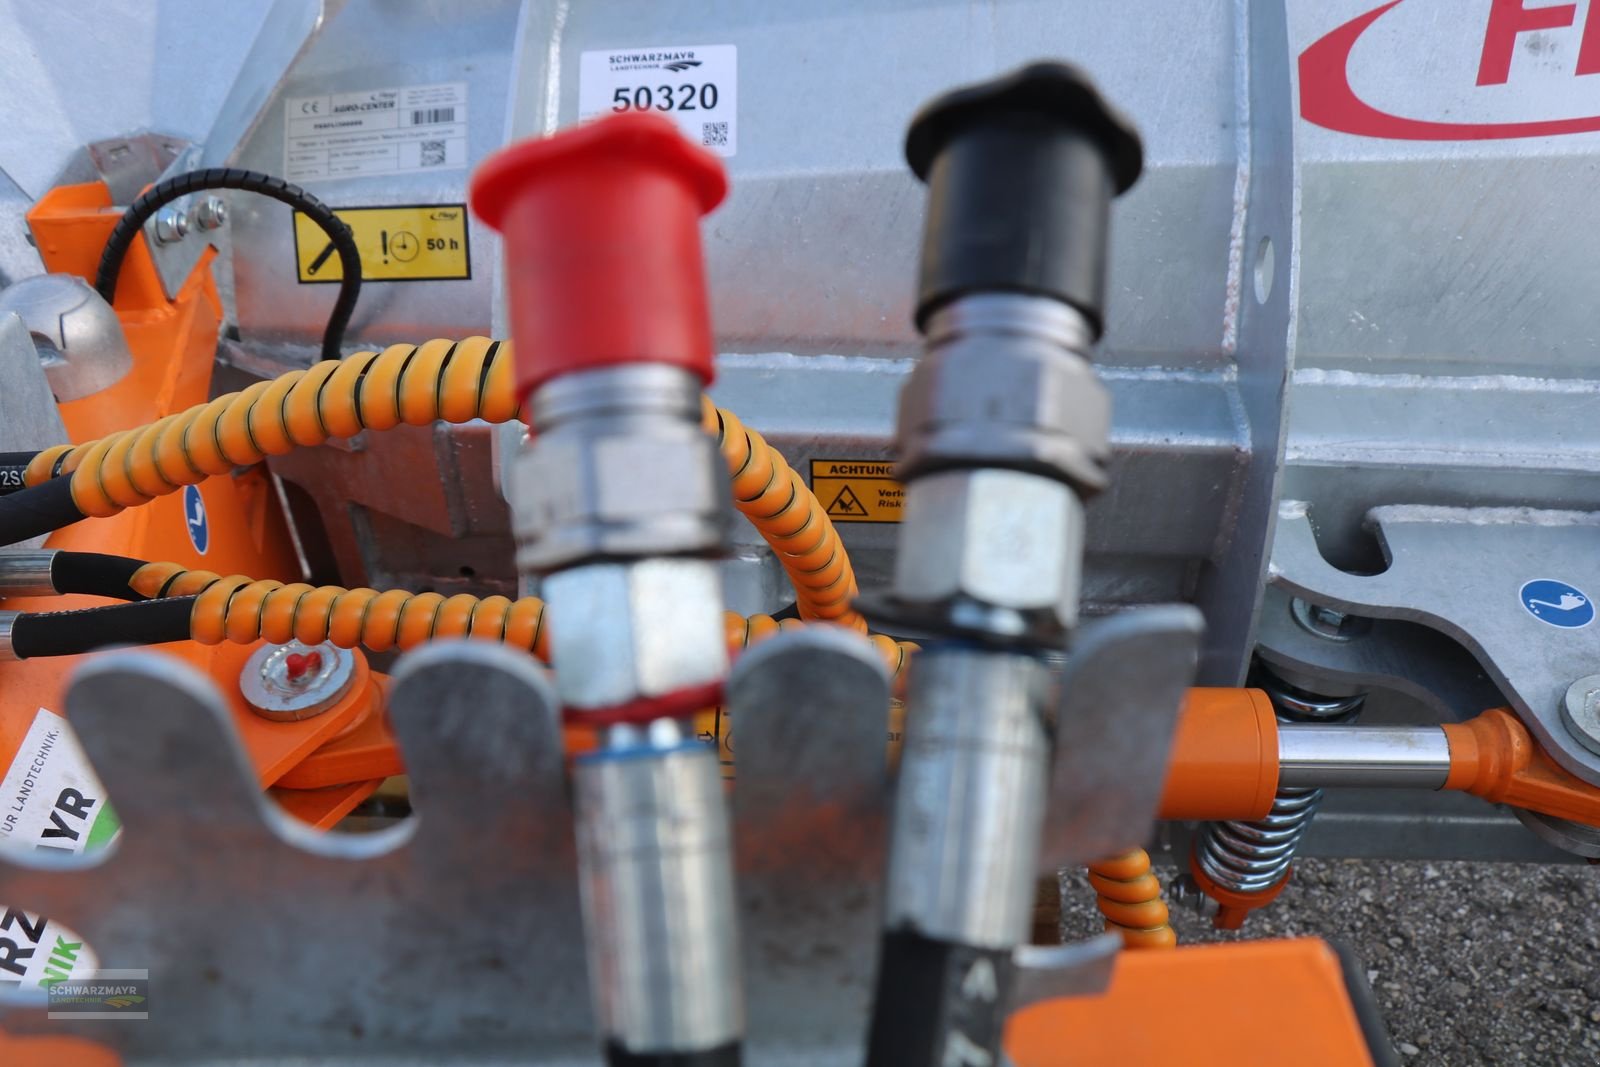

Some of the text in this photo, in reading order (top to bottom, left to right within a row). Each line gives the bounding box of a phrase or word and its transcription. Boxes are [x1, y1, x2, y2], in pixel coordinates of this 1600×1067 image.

[609, 51, 695, 64] SCHWARZMAYR
[610, 64, 660, 72] LANDTECHNIK
[612, 82, 718, 113] 50320
[427, 238, 459, 251] 50 h
[878, 499, 901, 508] Risk
[12, 730, 60, 812] LANDTECHNIK.
